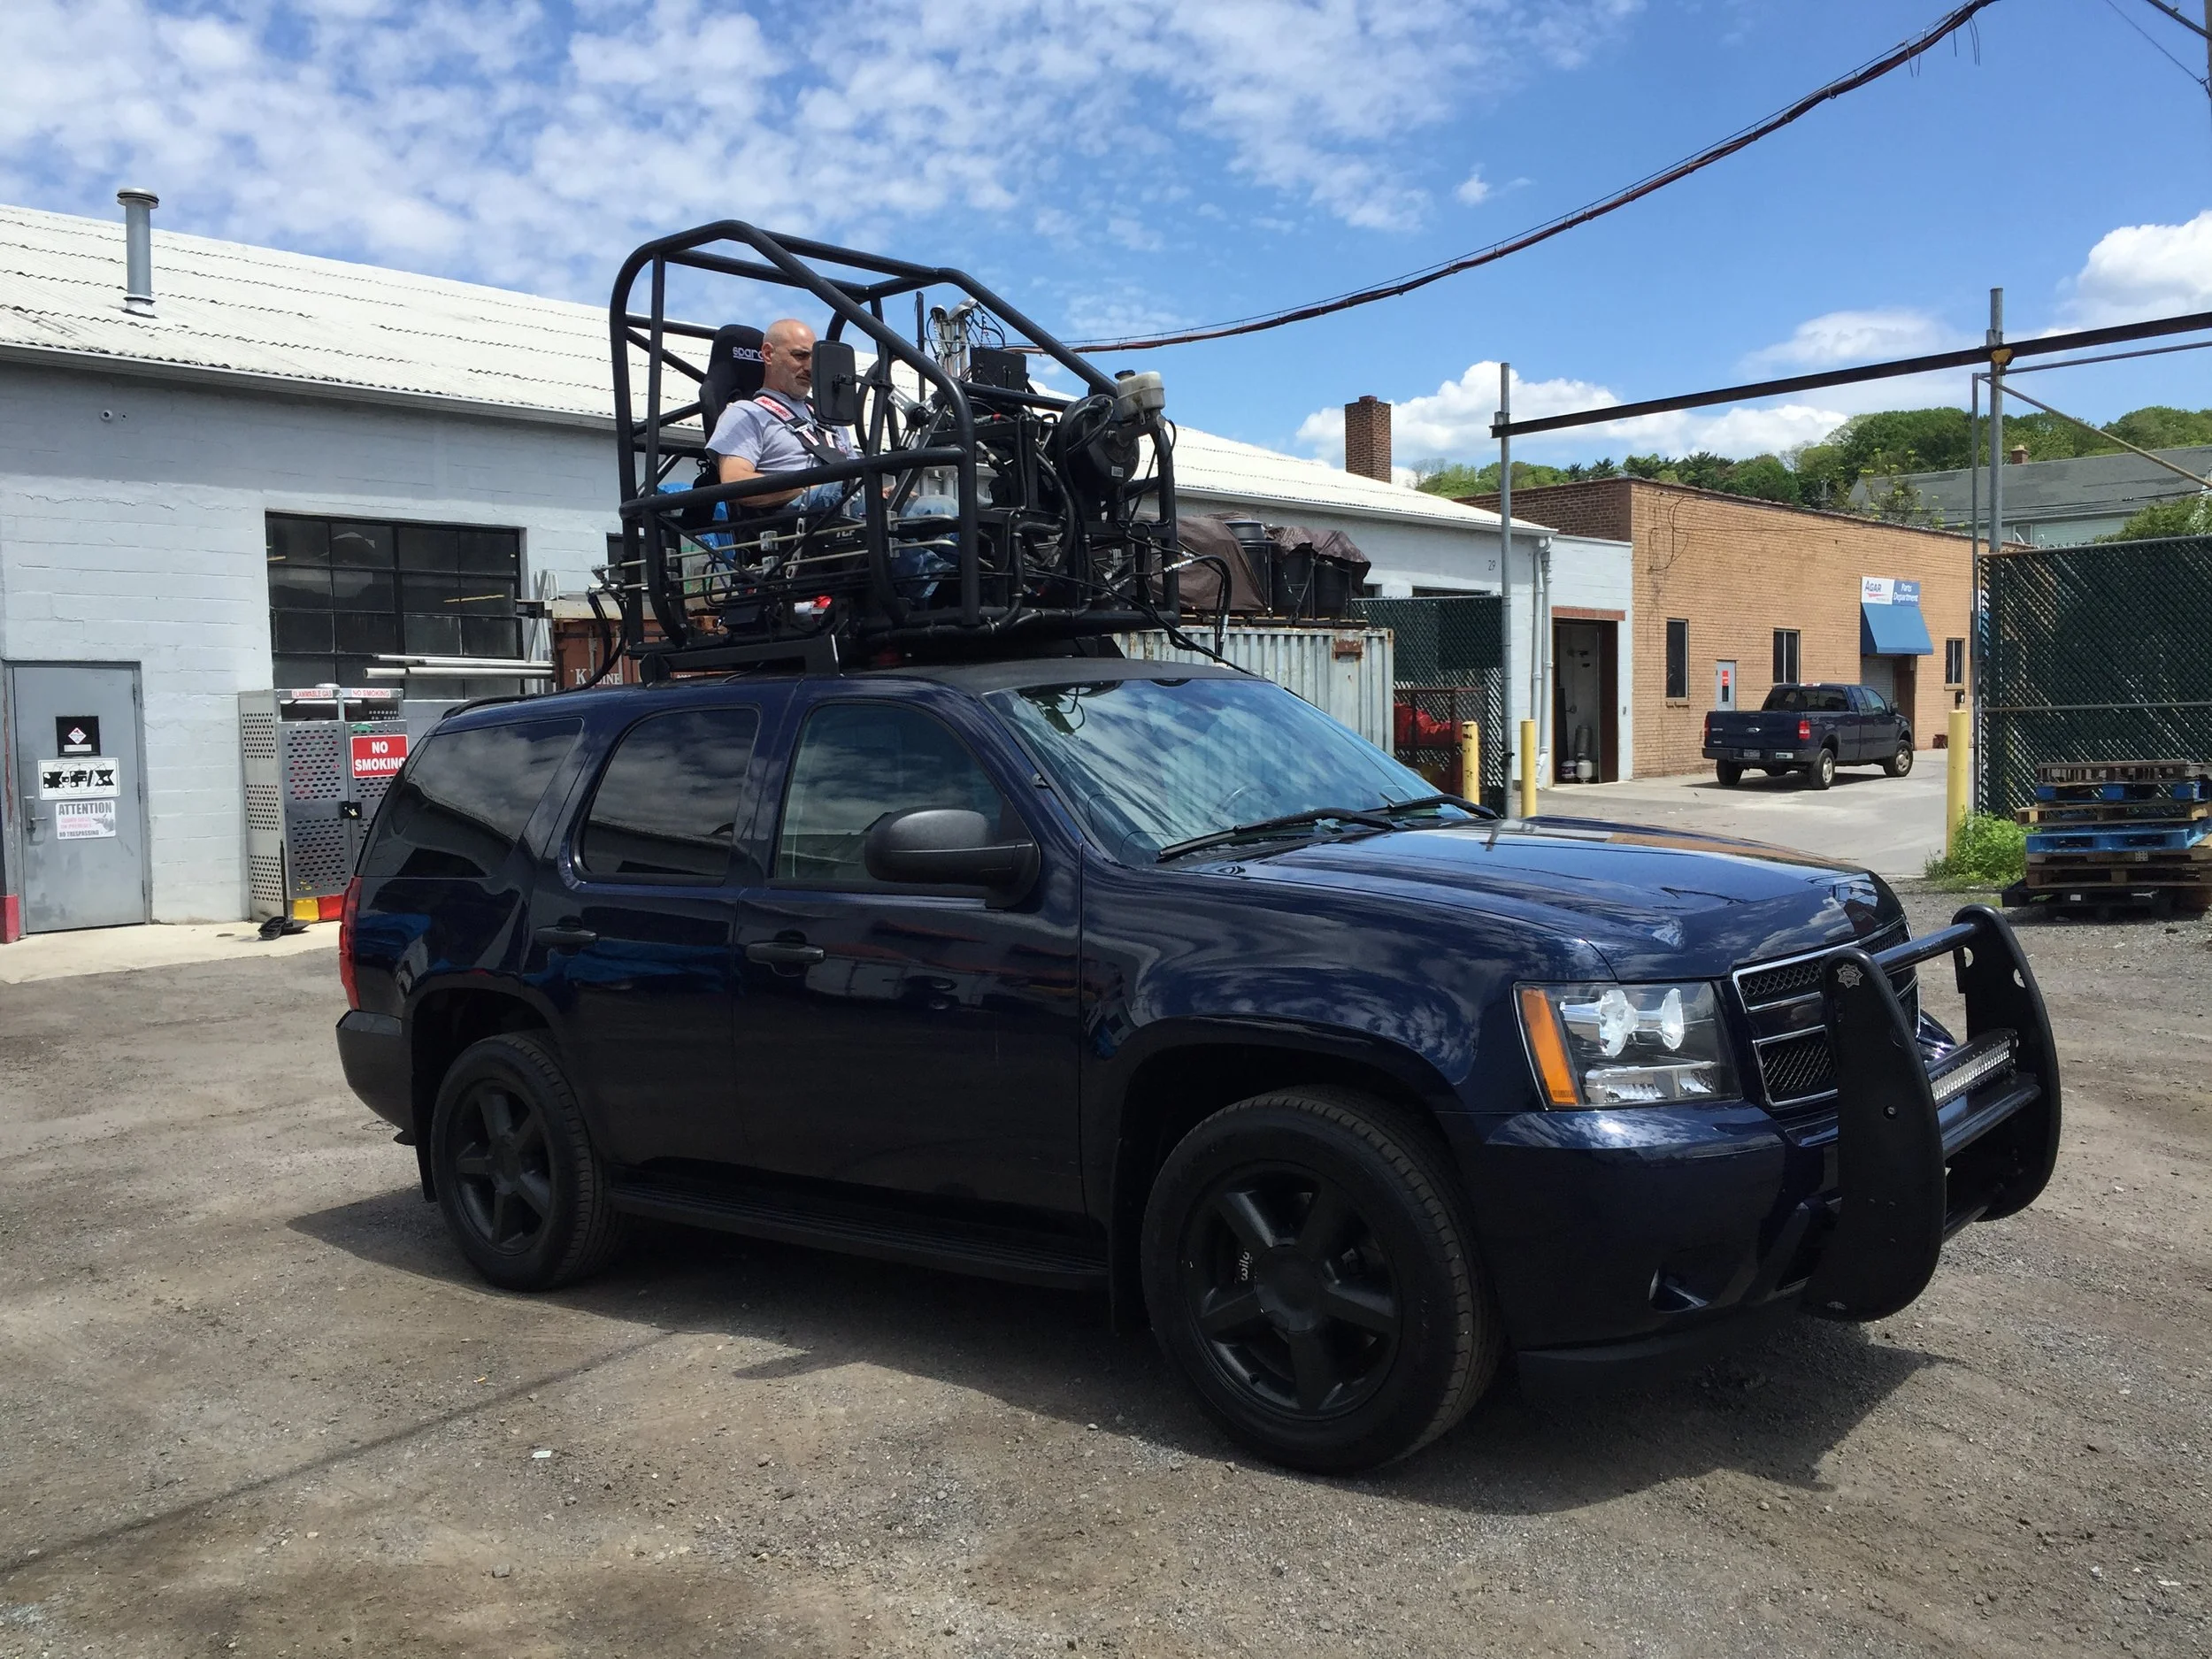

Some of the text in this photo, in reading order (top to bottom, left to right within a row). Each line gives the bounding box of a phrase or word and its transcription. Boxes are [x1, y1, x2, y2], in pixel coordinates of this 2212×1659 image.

[1893, 592, 1919, 603] Department
[372, 741, 388, 754] NO
[58, 802, 112, 815] ATTENTION
